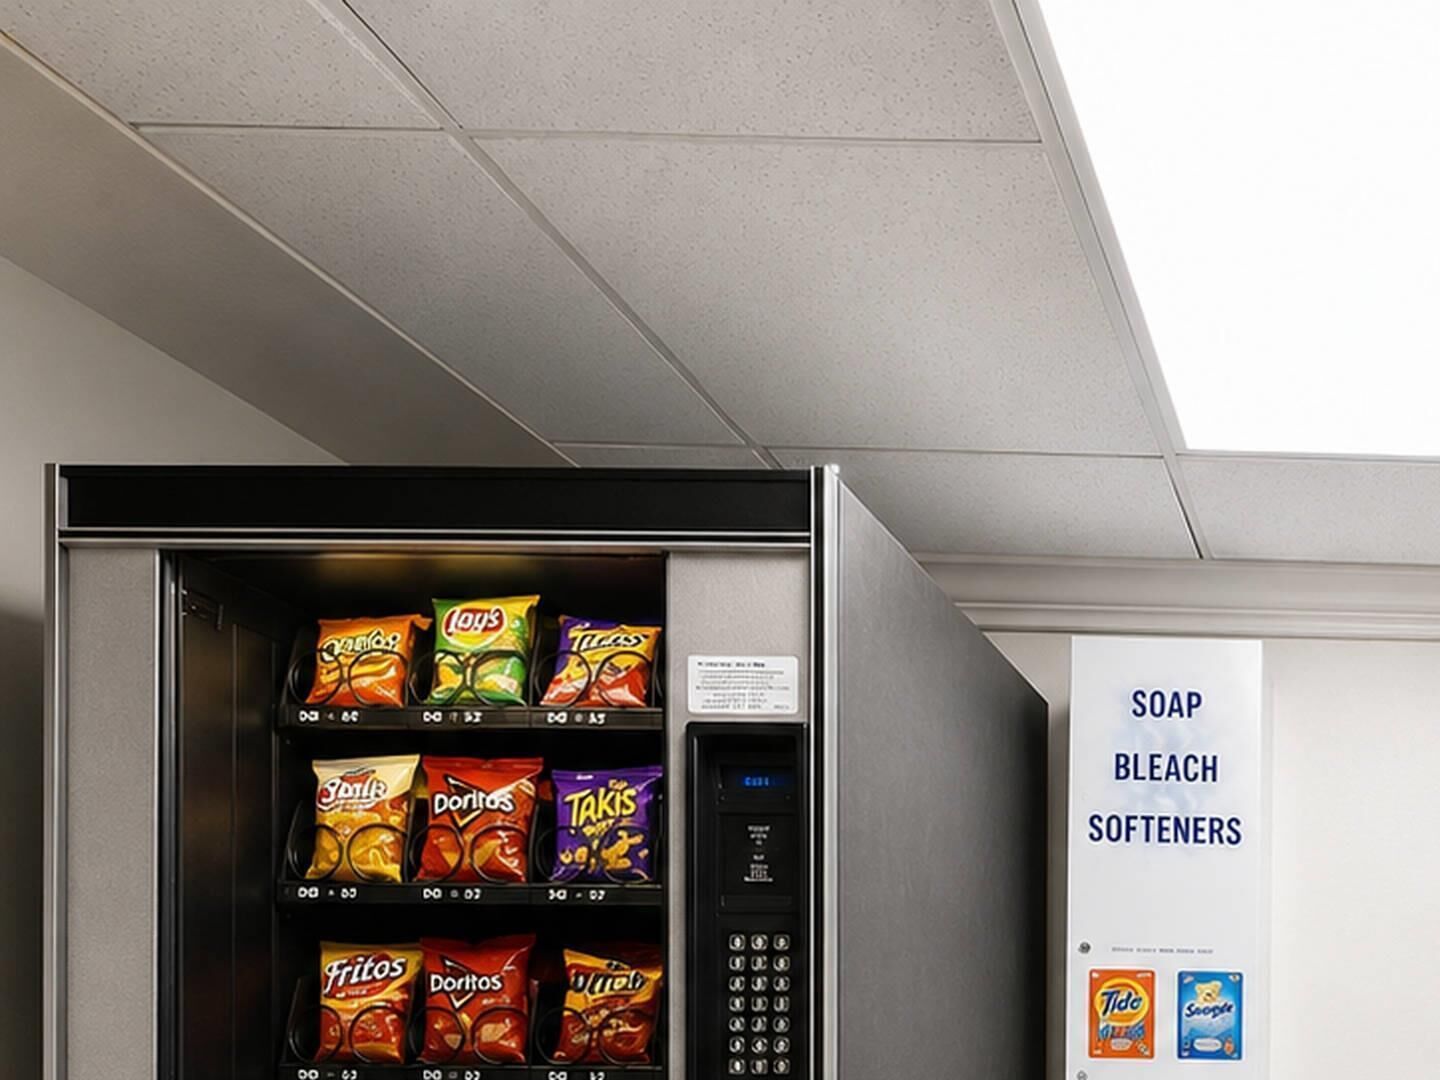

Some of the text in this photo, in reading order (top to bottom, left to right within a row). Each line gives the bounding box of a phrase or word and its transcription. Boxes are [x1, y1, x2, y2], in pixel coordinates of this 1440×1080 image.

[1132, 690, 1202, 718] SOAP
[1115, 753, 1217, 782] BLEACH
[434, 790, 515, 814] Doritos
[565, 786, 637, 822] TAKIS
[1088, 814, 1242, 845] SOFTENERS
[322, 957, 406, 996] Fritos
[430, 972, 502, 993] Doritos
